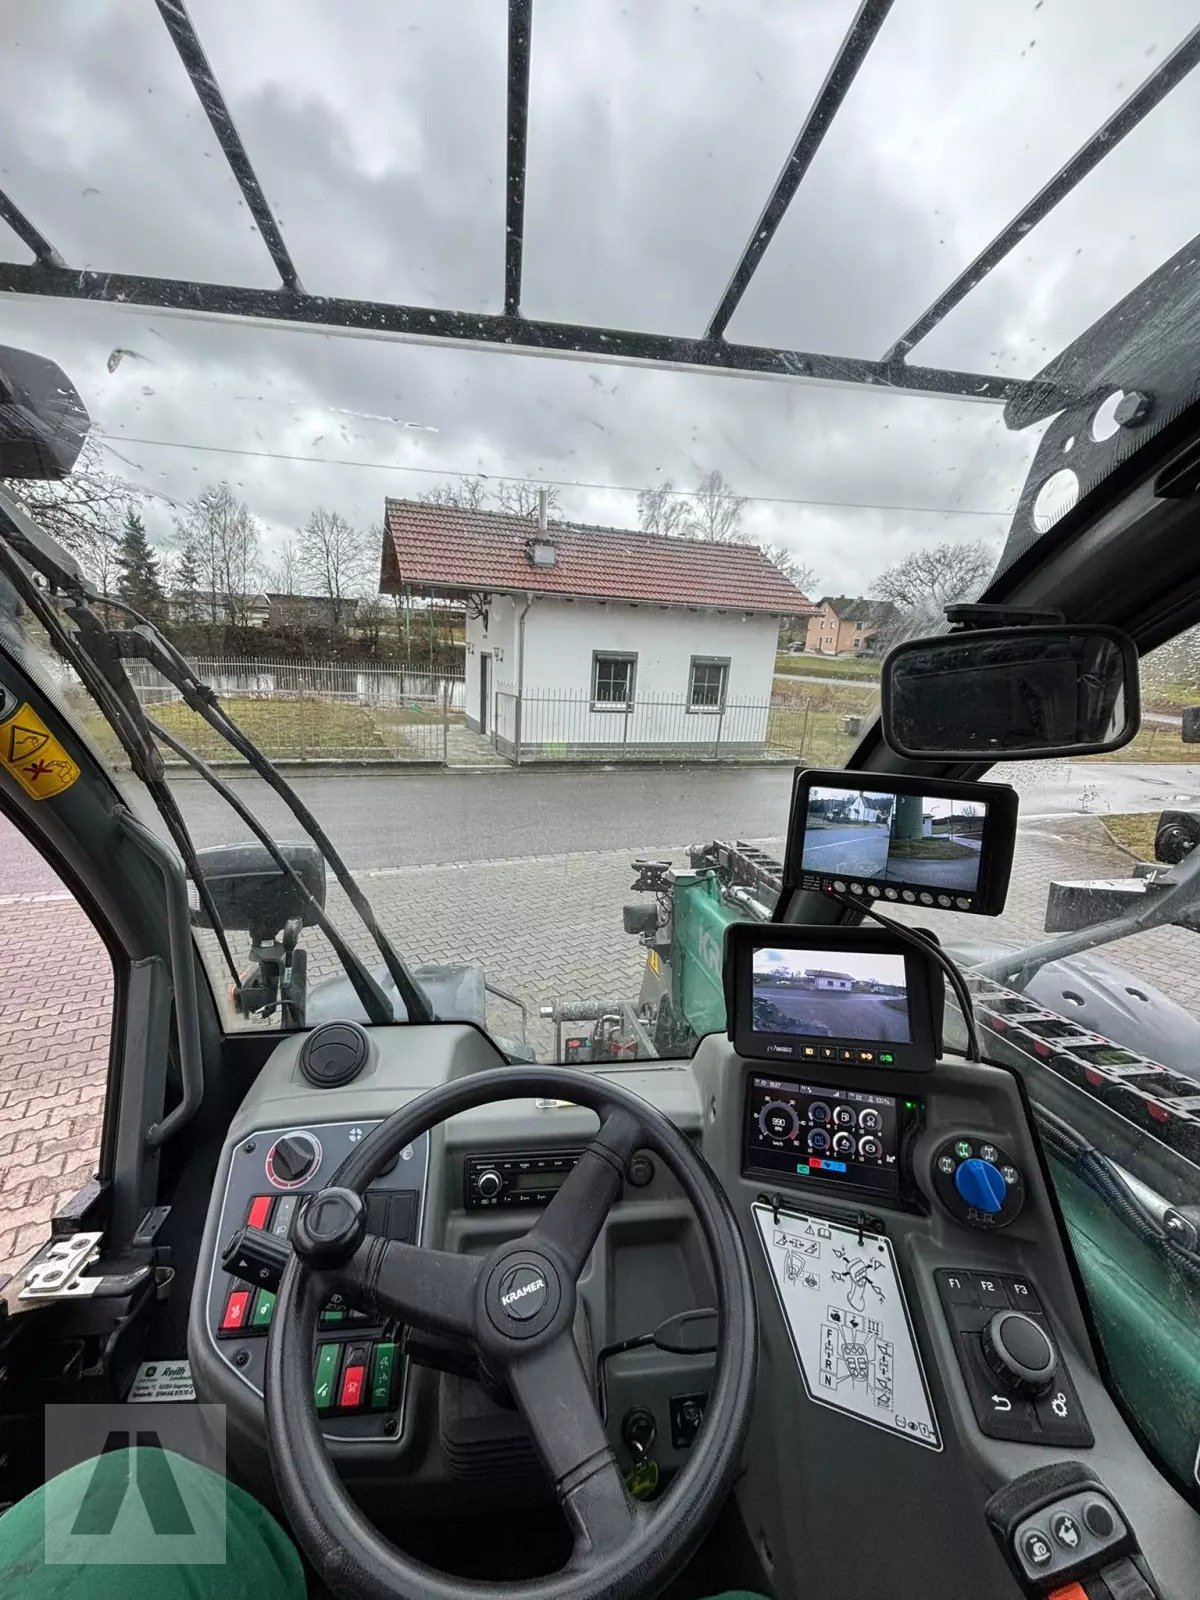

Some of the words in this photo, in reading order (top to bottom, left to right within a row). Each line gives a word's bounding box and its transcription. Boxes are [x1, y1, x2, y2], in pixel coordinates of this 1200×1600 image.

[948, 1278, 961, 1289] F1
[980, 1280, 995, 1292] F2
[501, 1279, 545, 1306] KRAMER
[1013, 1284, 1029, 1295] F3
[826, 1329, 833, 1338] F
[825, 1359, 832, 1371] R
[161, 1366, 186, 1377] Reith
[825, 1375, 832, 1386] N
